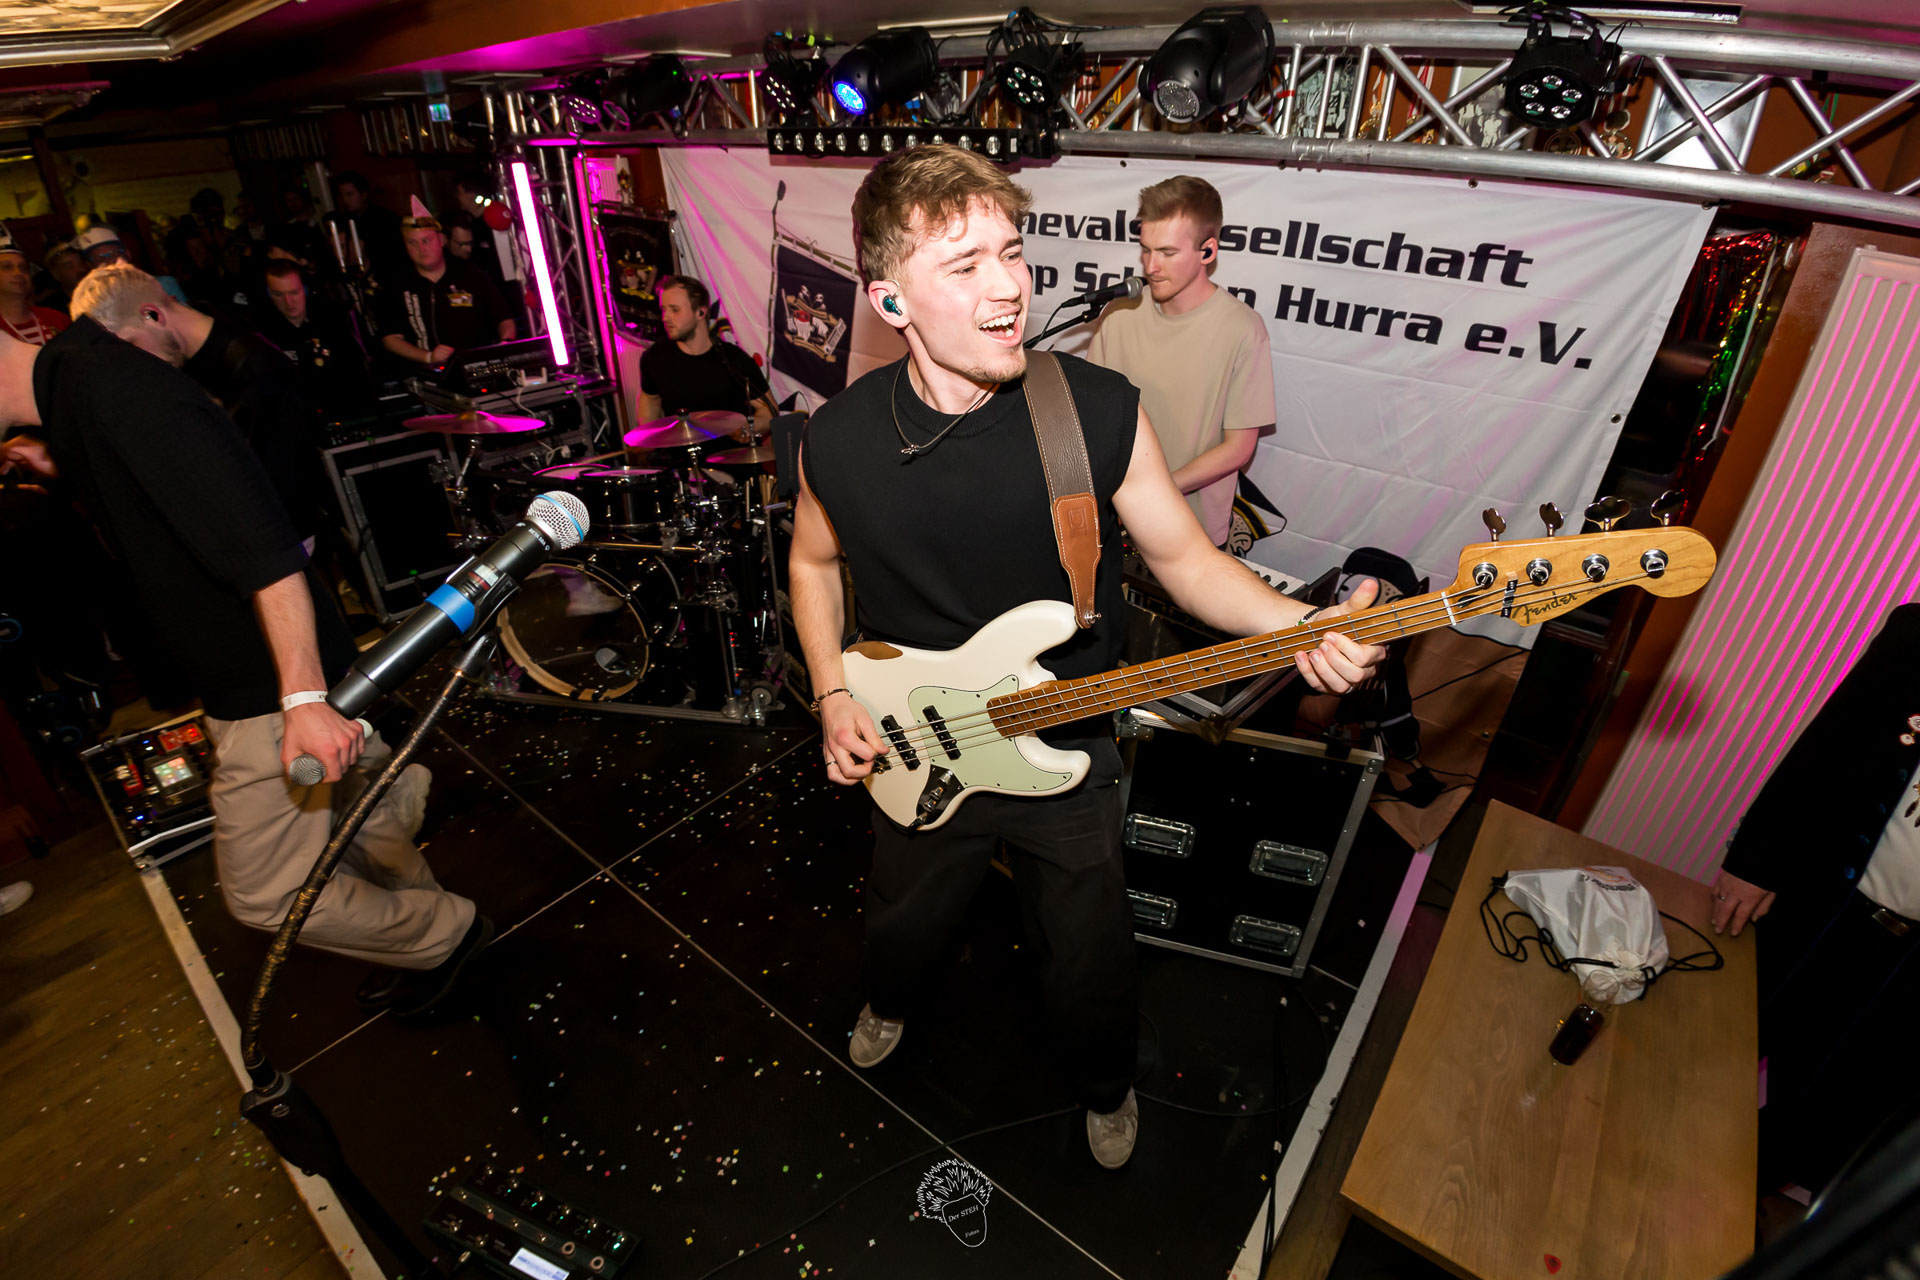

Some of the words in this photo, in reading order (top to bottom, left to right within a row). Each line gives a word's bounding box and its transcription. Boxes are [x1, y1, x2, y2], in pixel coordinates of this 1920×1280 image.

[1273, 284, 1445, 345] Hurra
[1463, 320, 1594, 370] e.V.
[1511, 590, 1578, 624] Fender
